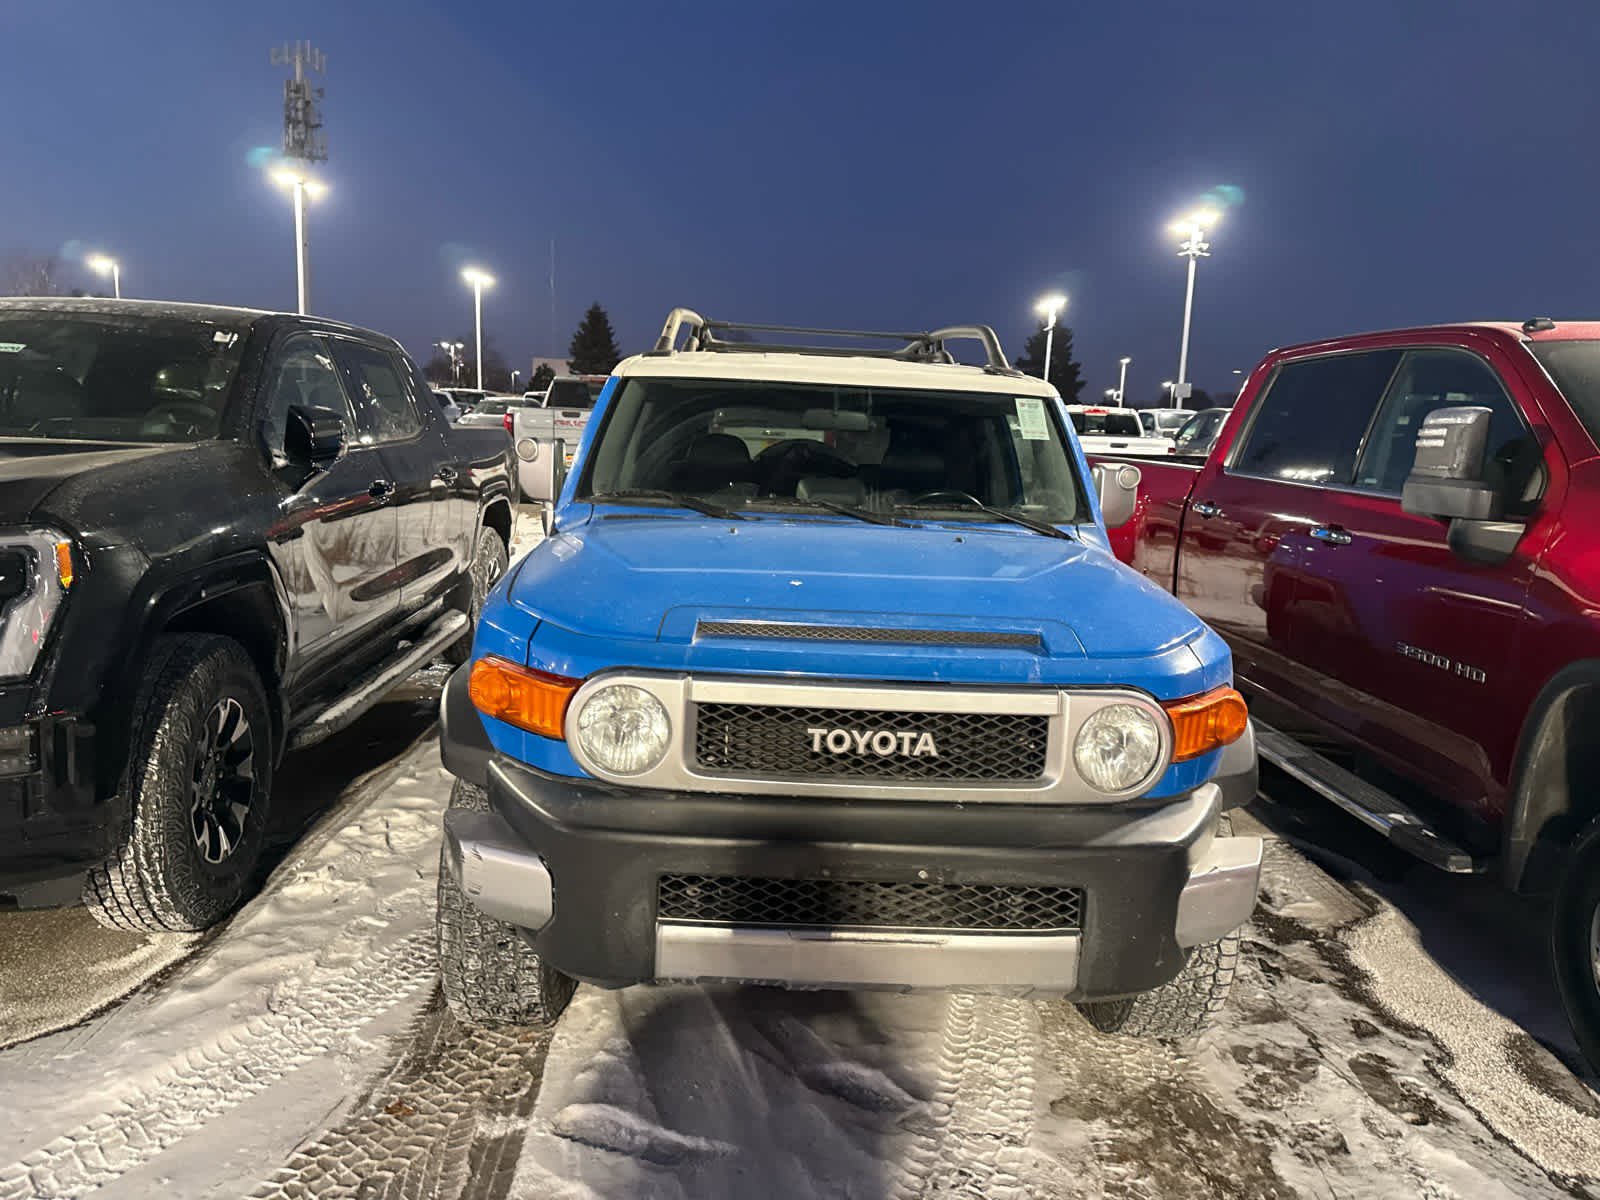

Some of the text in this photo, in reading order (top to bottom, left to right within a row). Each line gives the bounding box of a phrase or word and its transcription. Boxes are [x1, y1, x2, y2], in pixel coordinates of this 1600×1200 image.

[1395, 641, 1487, 684] 3500 HD
[807, 728, 938, 757] TOYOTA
